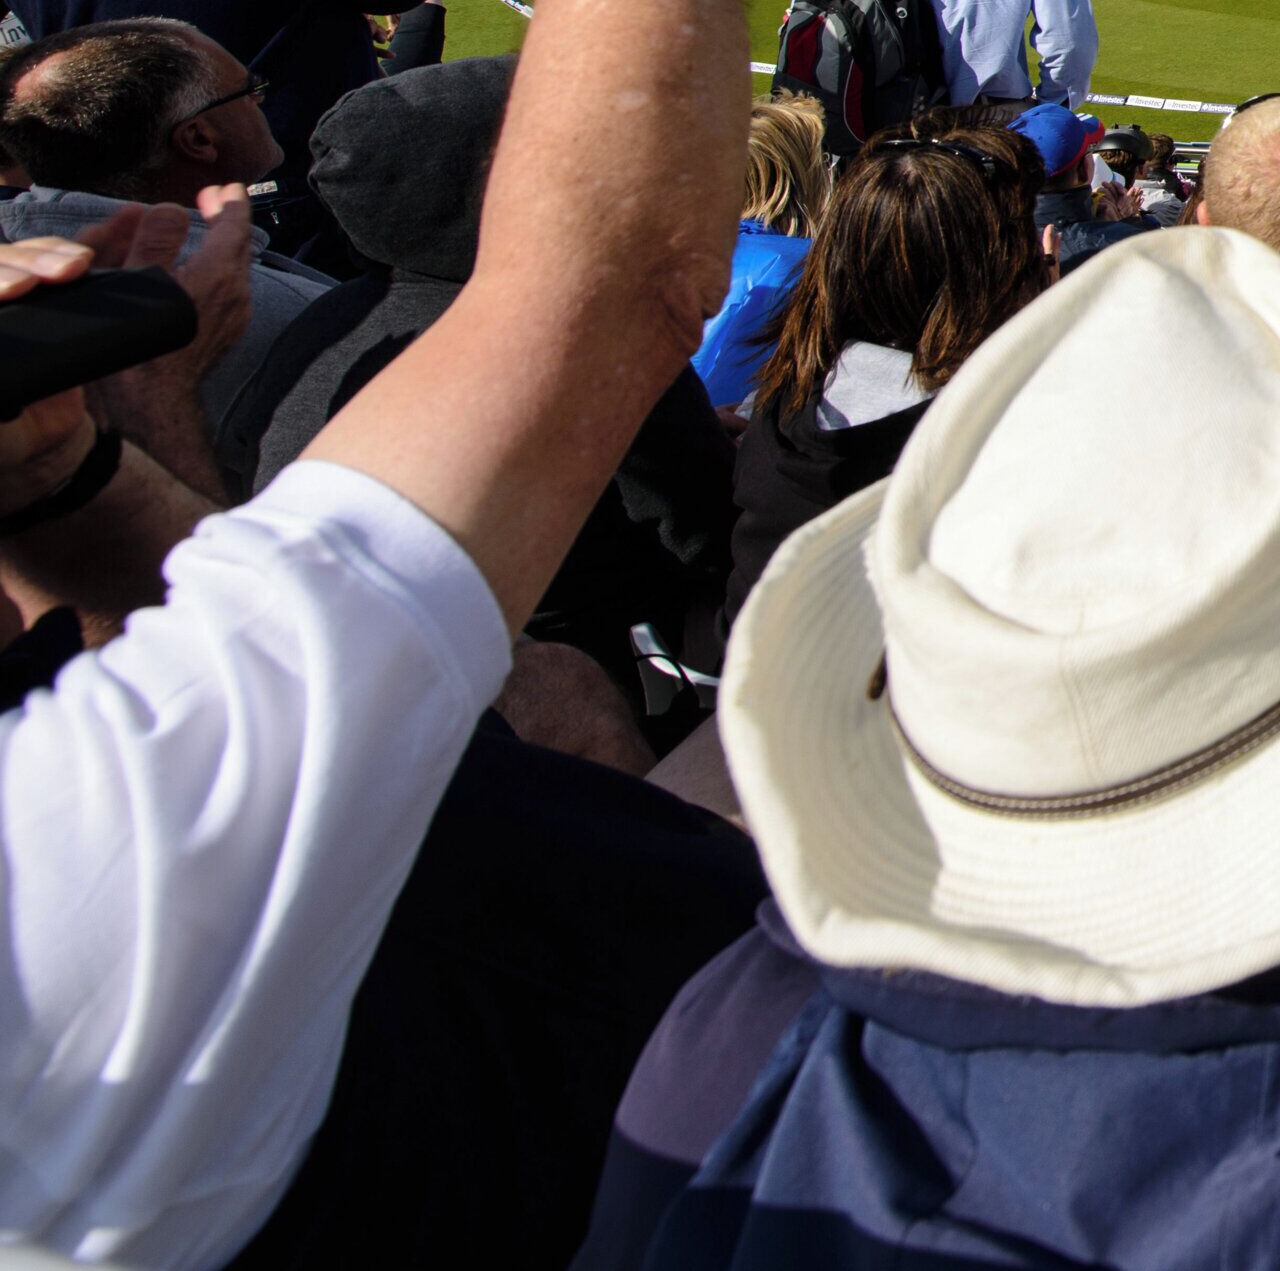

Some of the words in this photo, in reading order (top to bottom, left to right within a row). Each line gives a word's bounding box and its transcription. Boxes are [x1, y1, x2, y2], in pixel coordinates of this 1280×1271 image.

[1098, 95, 1124, 104] Investec
[1134, 97, 1163, 106] Investec
[1172, 101, 1199, 110] Investec
